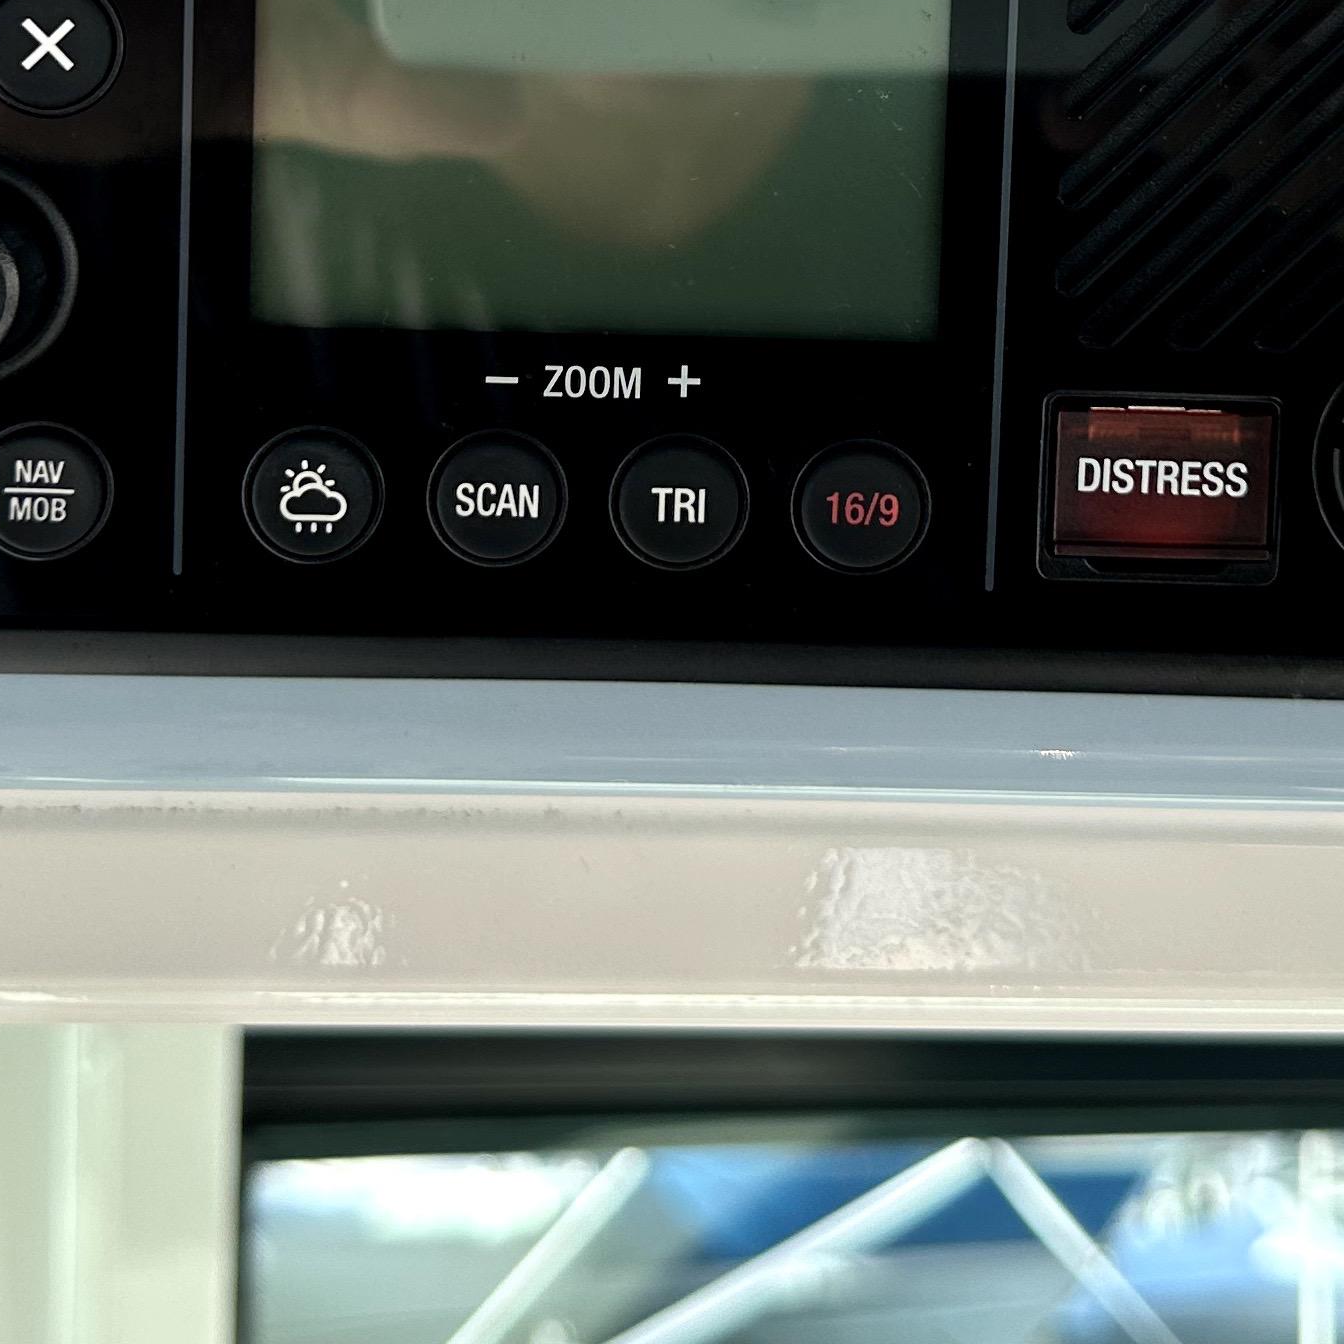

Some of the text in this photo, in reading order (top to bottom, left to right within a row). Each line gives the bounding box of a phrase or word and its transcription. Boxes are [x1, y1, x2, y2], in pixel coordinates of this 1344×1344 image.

[543, 364, 642, 399] ZOOM
[14, 459, 65, 485] NAV
[1077, 457, 1248, 498] DISTRESS
[8, 496, 67, 523] MOB
[455, 482, 540, 519] SCAN
[651, 487, 706, 524] TRI
[825, 491, 899, 527] 16/9
